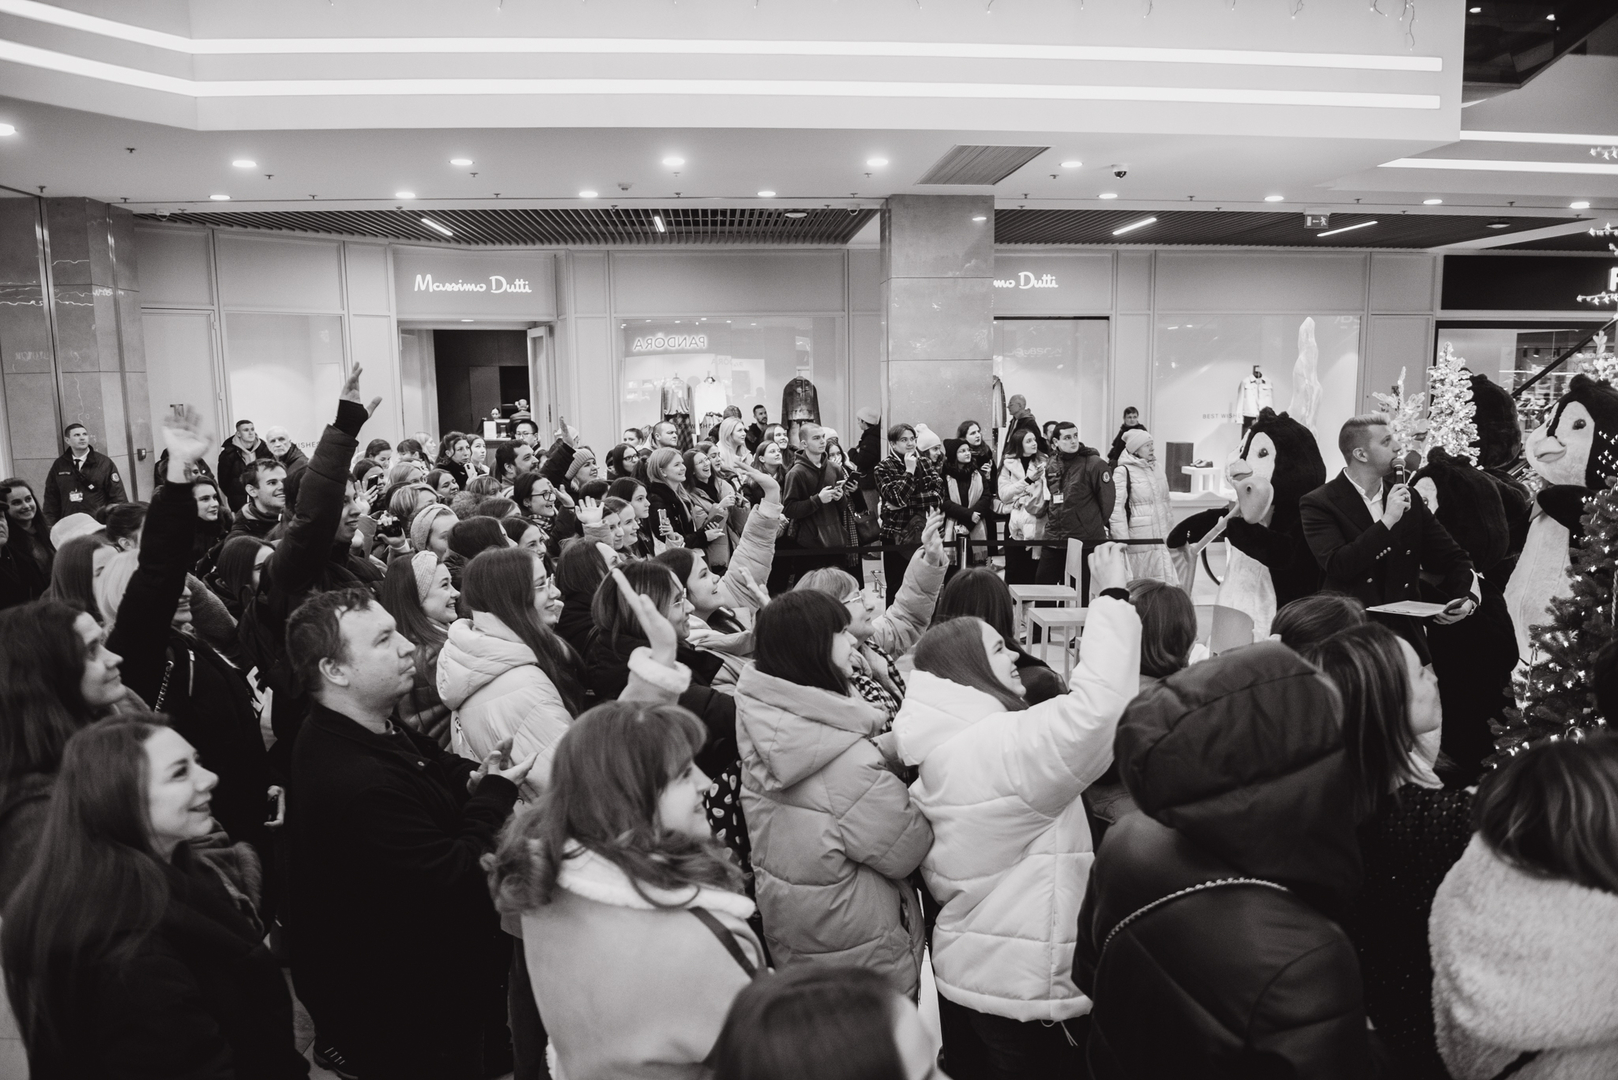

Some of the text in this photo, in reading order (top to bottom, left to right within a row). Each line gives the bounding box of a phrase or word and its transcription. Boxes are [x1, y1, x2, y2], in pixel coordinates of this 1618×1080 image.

[414, 274, 532, 293] Massimo Dutti
[1018, 271, 1058, 289] Dutti
